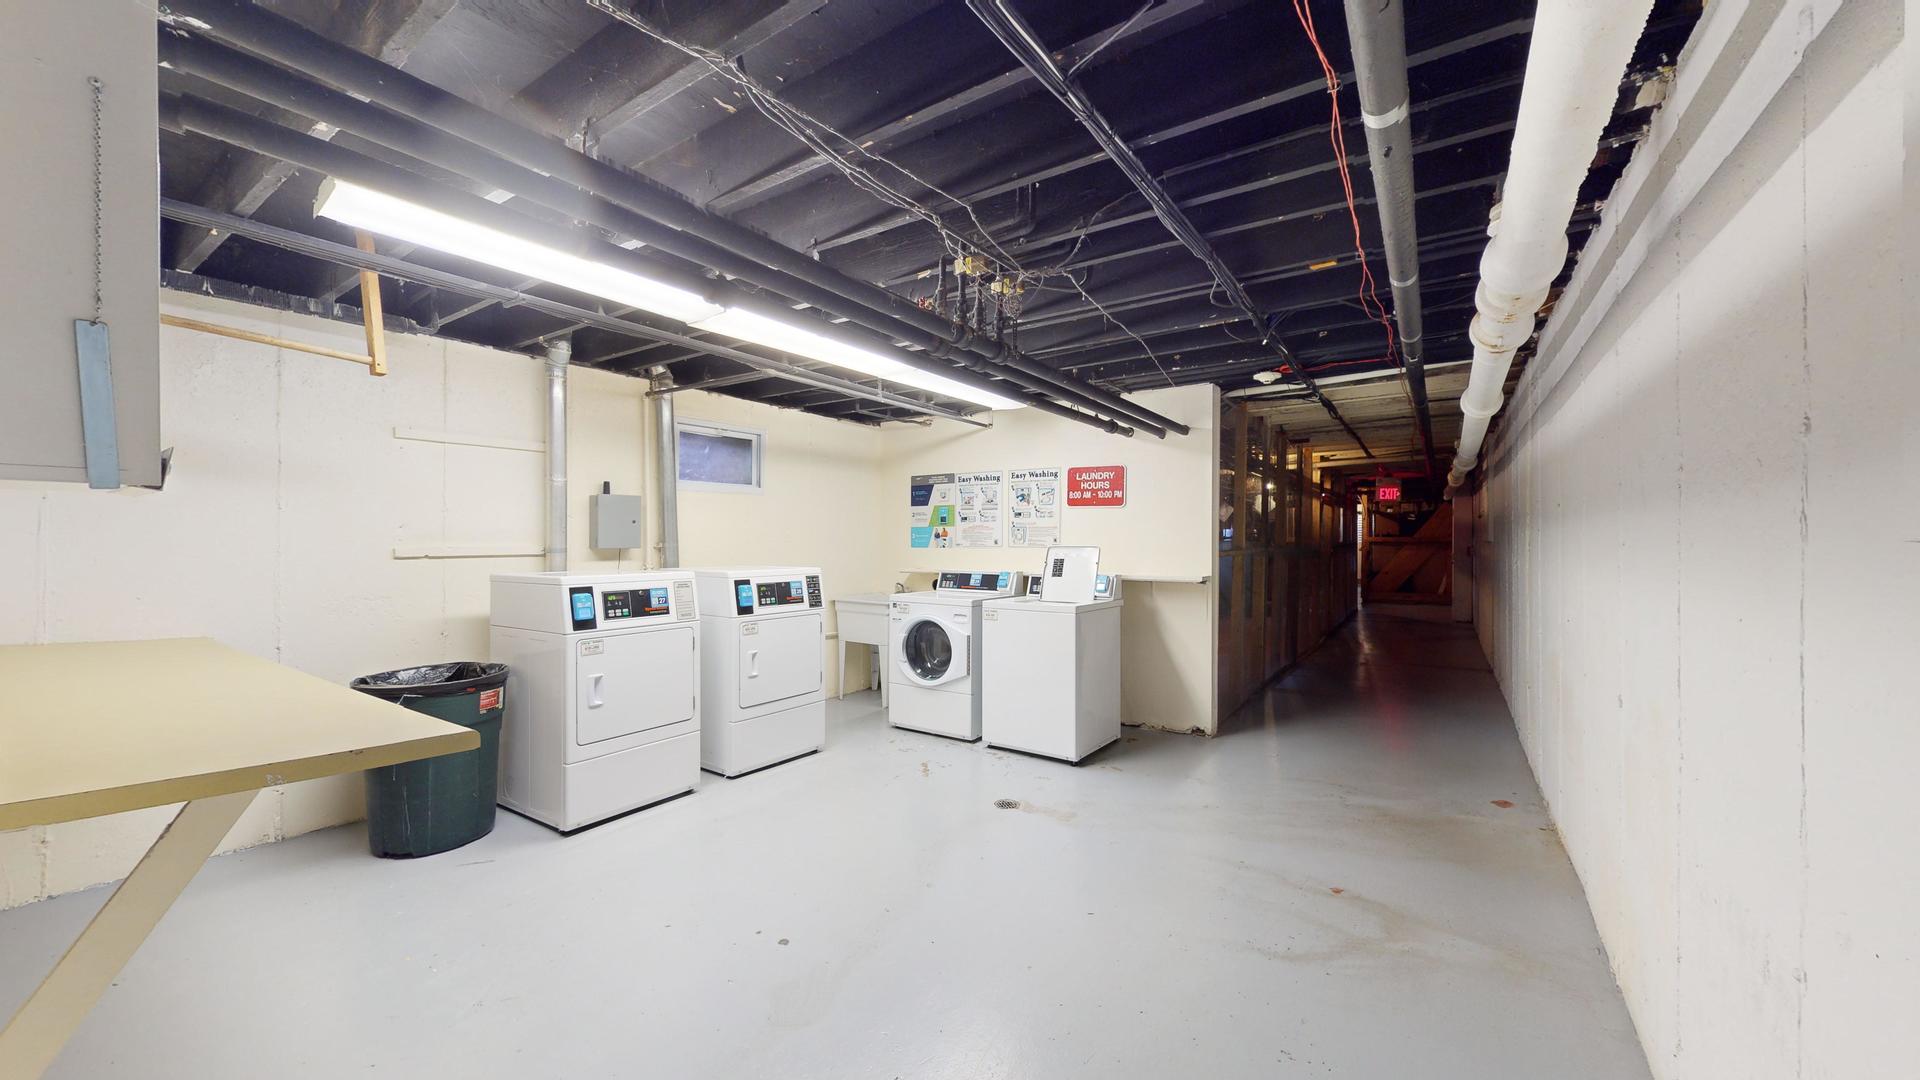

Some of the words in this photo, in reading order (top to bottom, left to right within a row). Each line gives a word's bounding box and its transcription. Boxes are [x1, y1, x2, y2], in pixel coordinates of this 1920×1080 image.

[957, 476, 972, 484] Easy
[973, 474, 1000, 483] Washing
[1011, 472, 1026, 480] Easy
[1028, 470, 1059, 479] Washing
[1076, 471, 1115, 480] LAUNDRY
[1080, 481, 1110, 489] HOURS
[1069, 491, 1081, 499] 8:00
[1083, 490, 1091, 498] AM
[1097, 490, 1112, 498] 10:00
[1113, 490, 1122, 498] PM
[1380, 488, 1398, 499] EXIT
